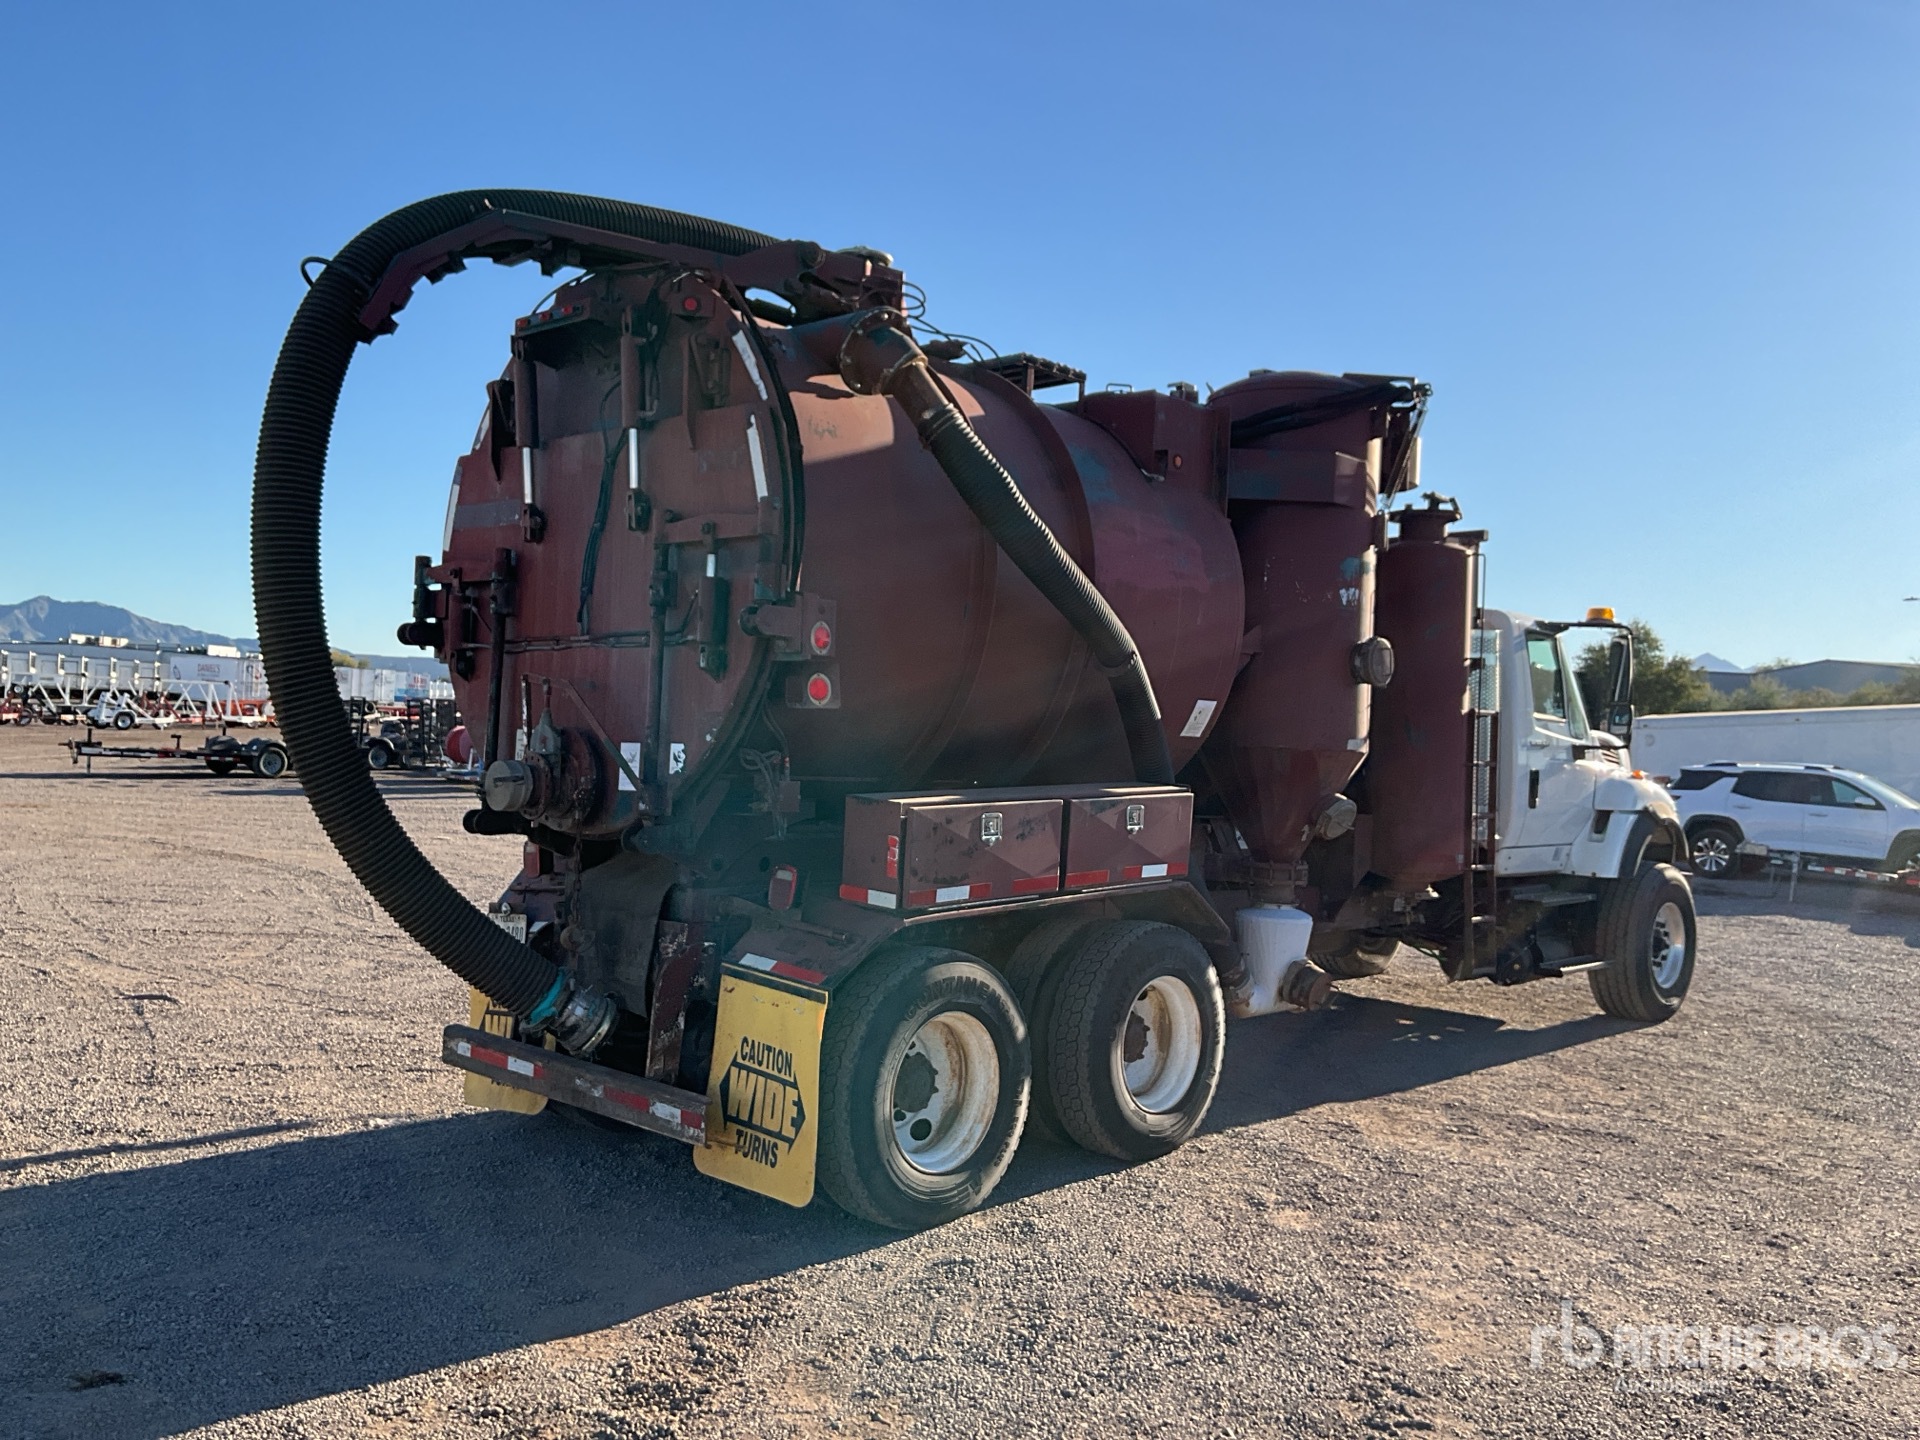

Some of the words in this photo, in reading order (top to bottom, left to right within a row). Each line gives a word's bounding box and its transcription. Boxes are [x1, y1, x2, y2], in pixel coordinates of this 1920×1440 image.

[740, 1036, 793, 1075] CAUTION
[727, 1067, 800, 1138] WIDE
[734, 1129, 779, 1168] TURNS
